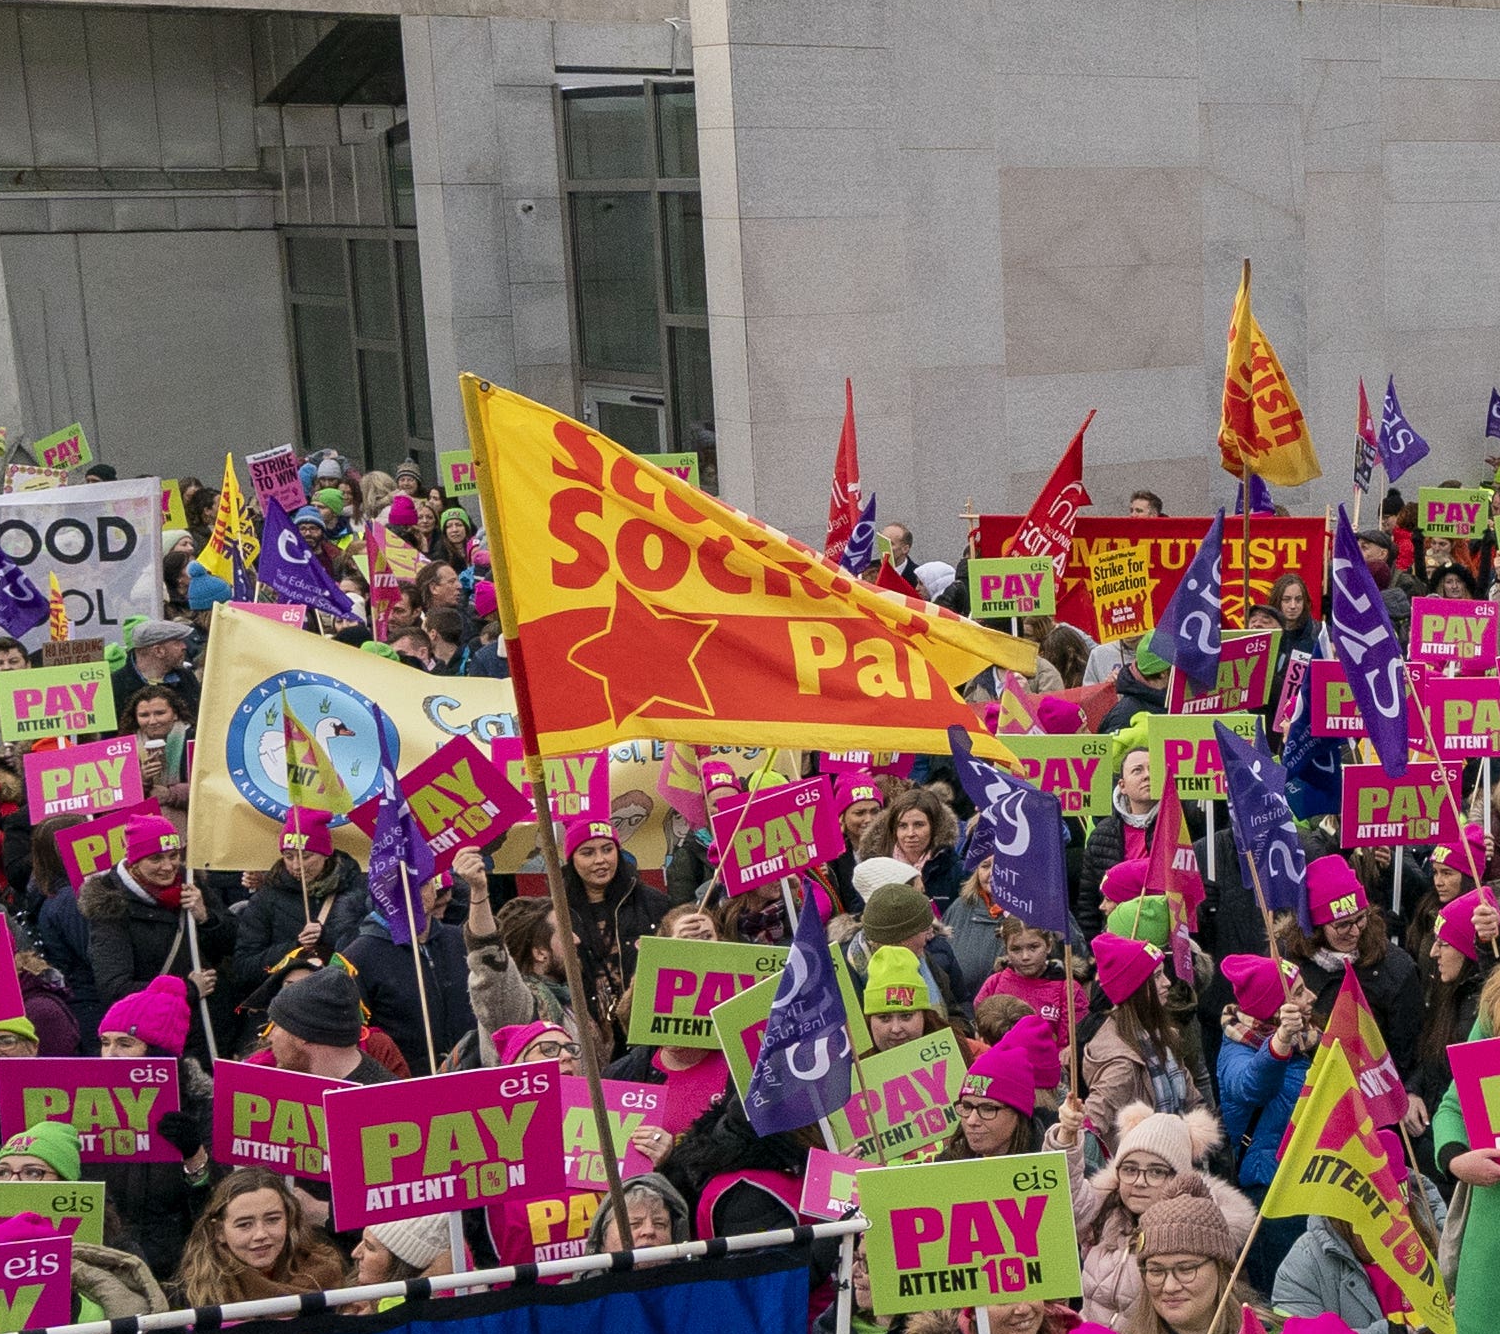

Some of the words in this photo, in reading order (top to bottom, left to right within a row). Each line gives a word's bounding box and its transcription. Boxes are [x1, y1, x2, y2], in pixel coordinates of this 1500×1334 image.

[252, 453, 294, 477] STRIKE
[255, 477, 274, 492] TO
[276, 468, 298, 486] WIN
[1029, 559, 1049, 572] eis
[1093, 564, 1125, 582] Strike
[1126, 558, 1144, 574] for
[980, 572, 1042, 601] PAY
[1095, 574, 1148, 597] education
[80, 666, 104, 681] eis
[13, 681, 100, 720] PAY
[501, 1072, 549, 1099] eis
[360, 1100, 539, 1186] PAY
[1013, 1167, 1058, 1192] eis
[890, 1195, 1049, 1271] PAY
